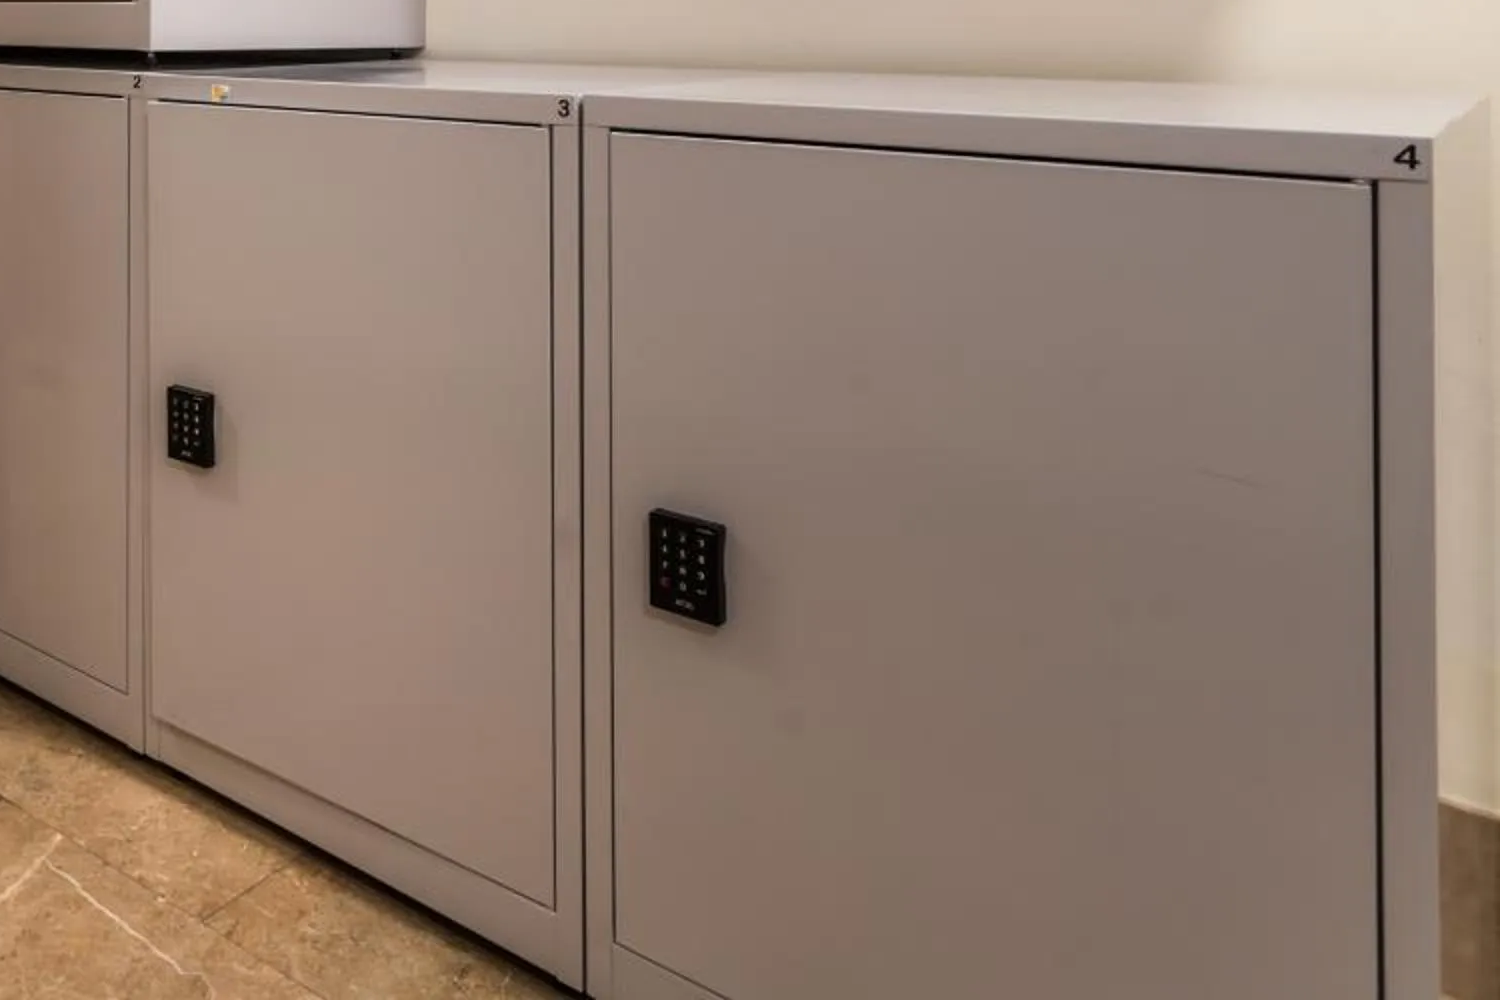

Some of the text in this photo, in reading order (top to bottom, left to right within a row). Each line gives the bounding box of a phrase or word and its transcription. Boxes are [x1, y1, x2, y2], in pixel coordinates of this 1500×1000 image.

[133, 75, 141, 89] 2
[557, 99, 570, 117] 3
[1393, 144, 1421, 170] 4
